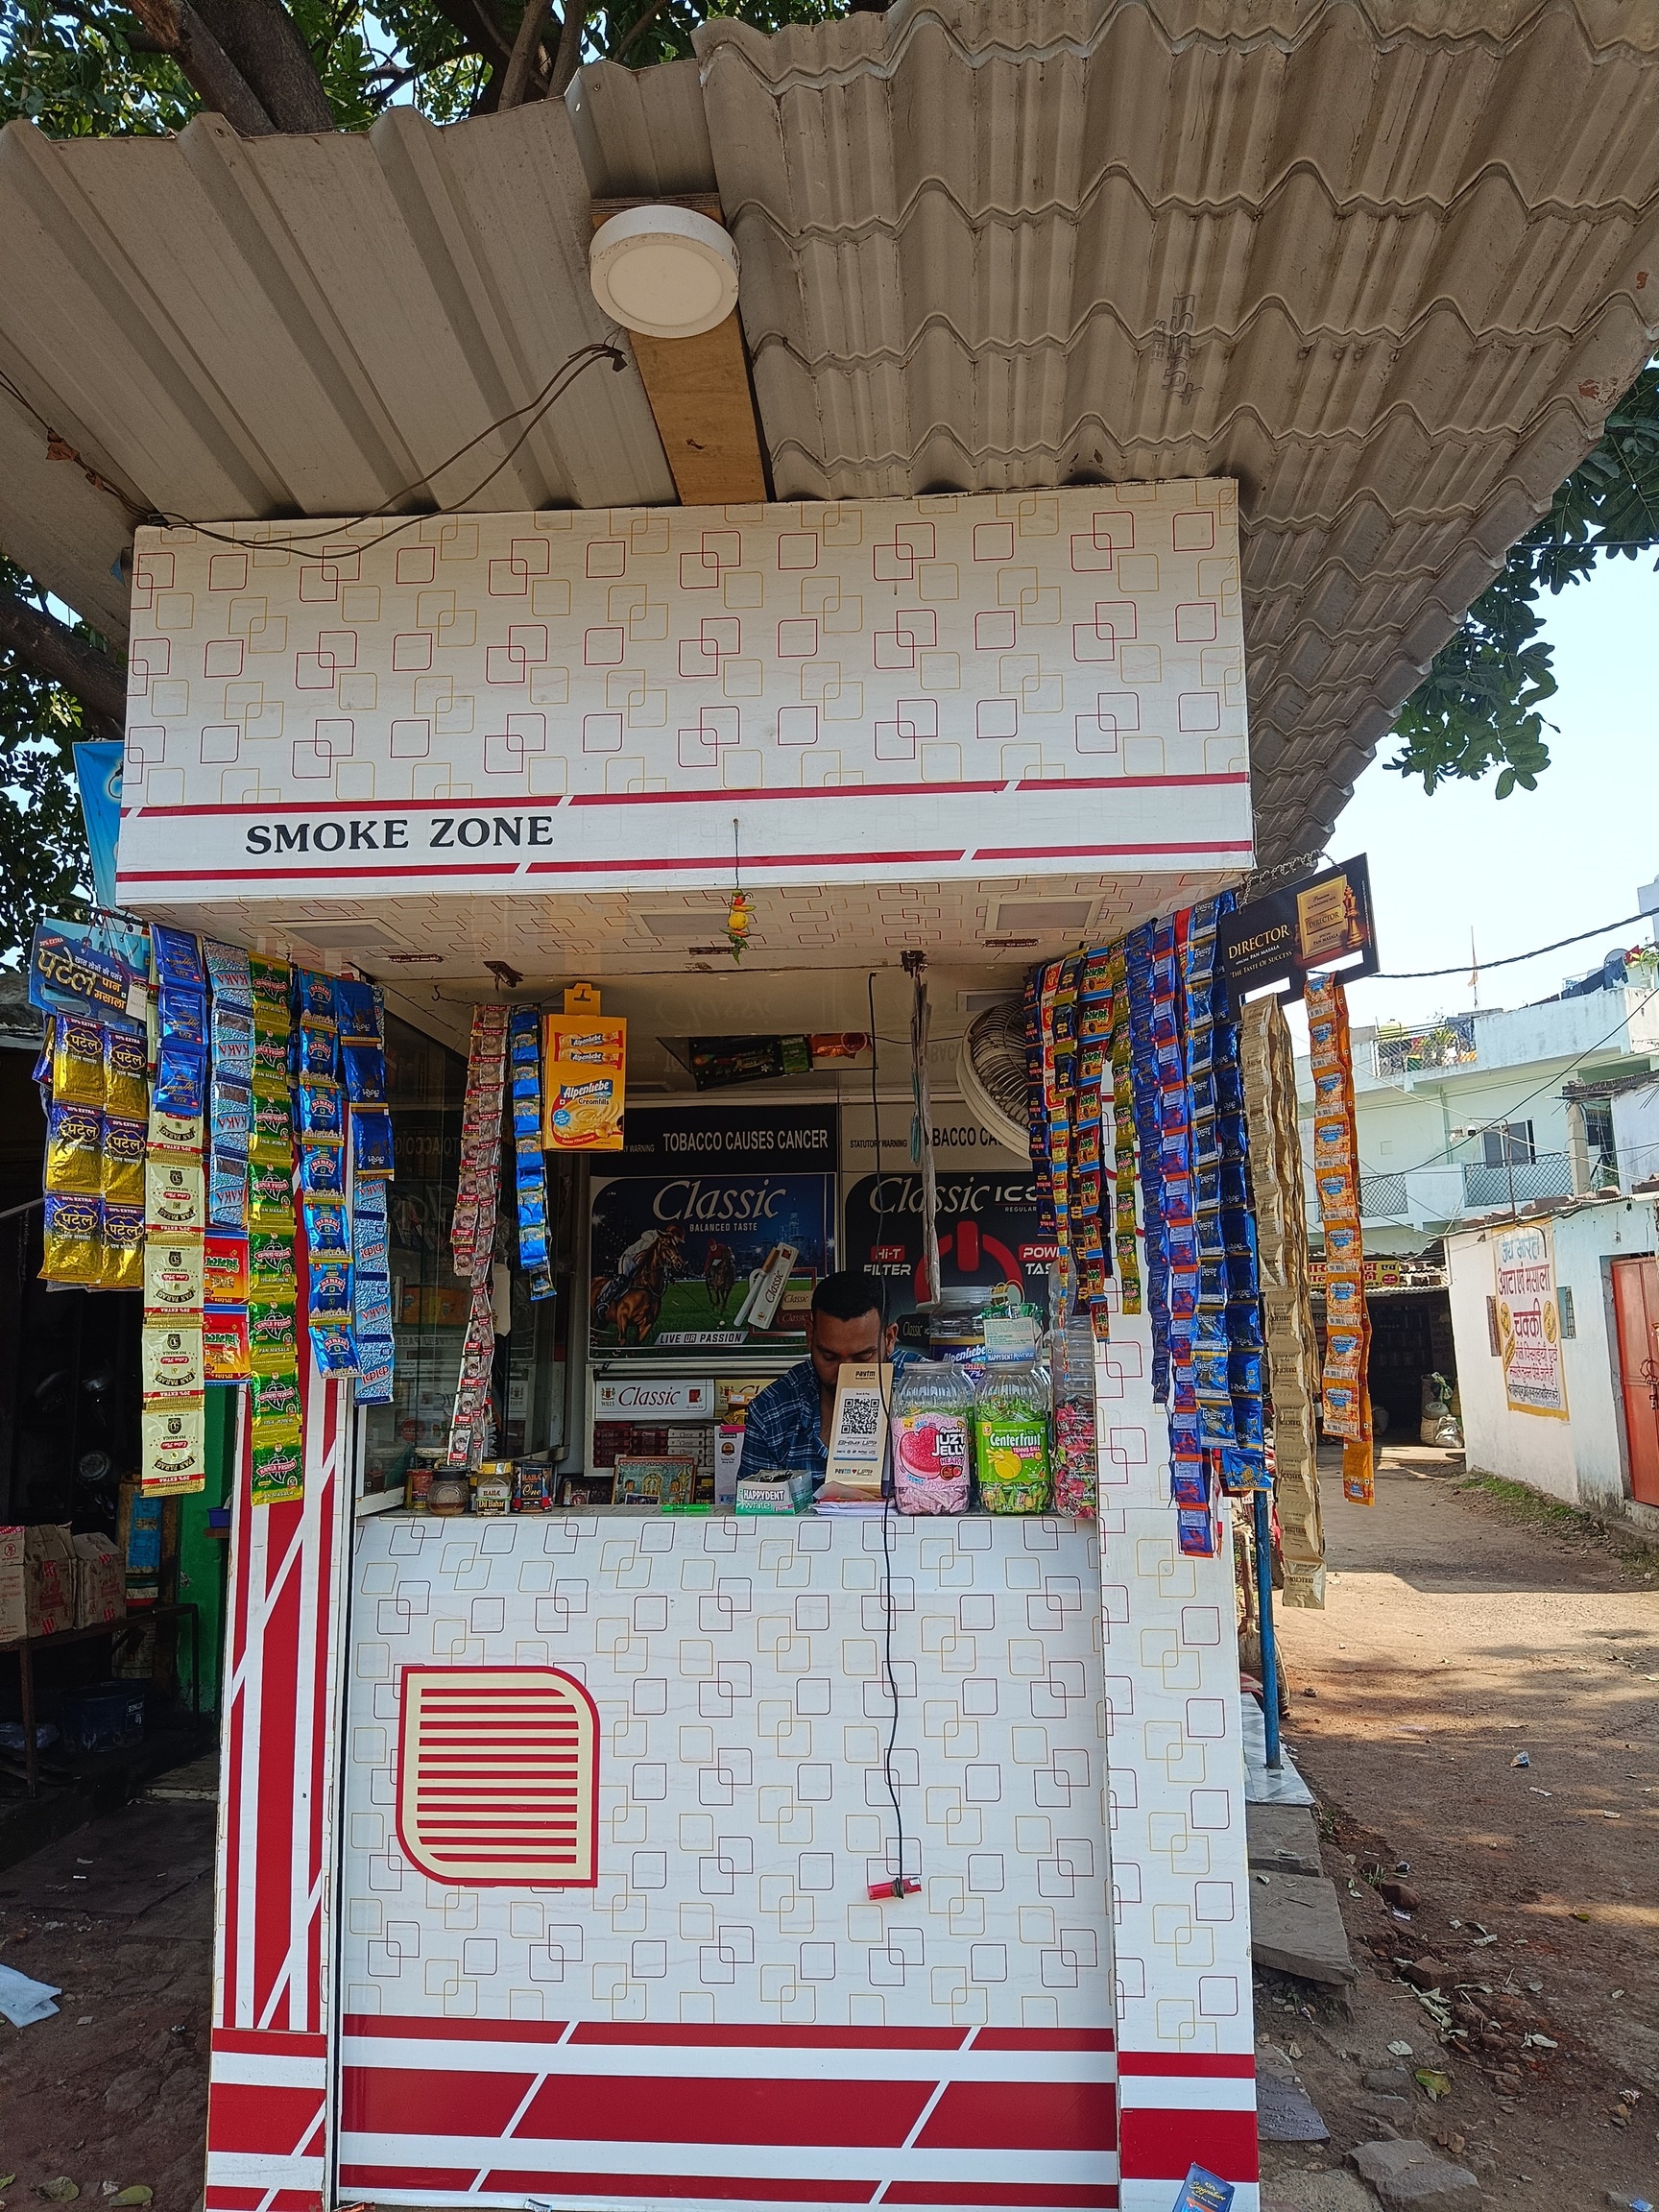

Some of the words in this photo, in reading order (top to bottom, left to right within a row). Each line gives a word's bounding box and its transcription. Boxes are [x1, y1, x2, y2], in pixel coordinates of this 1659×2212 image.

[245, 819, 409, 854] SMOKE
[429, 815, 554, 848] ZONE
[1309, 911, 1339, 928] DIRECTOR
[1228, 924, 1291, 960] DIRECTOR
[1322, 933, 1339, 944] MASALA
[1261, 945, 1281, 956] MASALA
[37, 946, 101, 997] पटेल
[1243, 963, 1259, 974] TASTE
[1260, 960, 1267, 969] OF
[102, 977, 122, 993] पान
[215, 974, 248, 985] KAKA
[94, 989, 127, 1009] मसाला
[70, 1033, 98, 1050] पटेल
[573, 1034, 603, 1046] Alpenliebe
[114, 1049, 142, 1066] पटेल
[218, 1044, 250, 1056] KAKA
[563, 1080, 610, 1100] Alpenliebe
[67, 1120, 97, 1138] पटेल
[217, 1115, 247, 1130] KAKA
[111, 1134, 141, 1151] पटेल
[662, 1132, 723, 1152] TOBACCO
[725, 1130, 774, 1150] CAUSES
[777, 1129, 829, 1149] CANCER
[850, 1139, 881, 1148] STATUTORY
[881, 1139, 908, 1148] WARNING
[926, 1127, 976, 1146] BACCO
[630, 1144, 655, 1153] WARNING
[652, 1178, 787, 1220] Classic
[869, 1176, 990, 1214] Classic
[60, 1210, 94, 1226] पटेल
[109, 1220, 138, 1237] पटेल
[689, 1223, 731, 1233] BALANCED
[733, 1222, 757, 1232] TASTE
[875, 1247, 902, 1260] Hi-T
[1022, 1247, 1060, 1259] POW
[863, 1263, 912, 1276] FILTER
[1024, 1263, 1052, 1275] TAS
[764, 1269, 785, 1304] Classic
[1498, 1266, 1517, 1296] आटा
[361, 1303, 388, 1320] KAKA
[1513, 1297, 1543, 1338] चक्की
[902, 1321, 924, 1337] Classic
[660, 1334, 682, 1343] LIVE
[684, 1333, 697, 1343] UR
[699, 1333, 743, 1343] PASSION
[943, 1345, 986, 1363] Alpenliebe
[180, 1373, 193, 1385] PAN
[617, 1385, 681, 1407] Classic
[179, 1459, 193, 1472] PAN
[941, 1456, 964, 1465] HEART
[522, 1484, 541, 1497] One
[742, 1489, 784, 1501] HAPPYDENT
[743, 1501, 772, 1509] white
